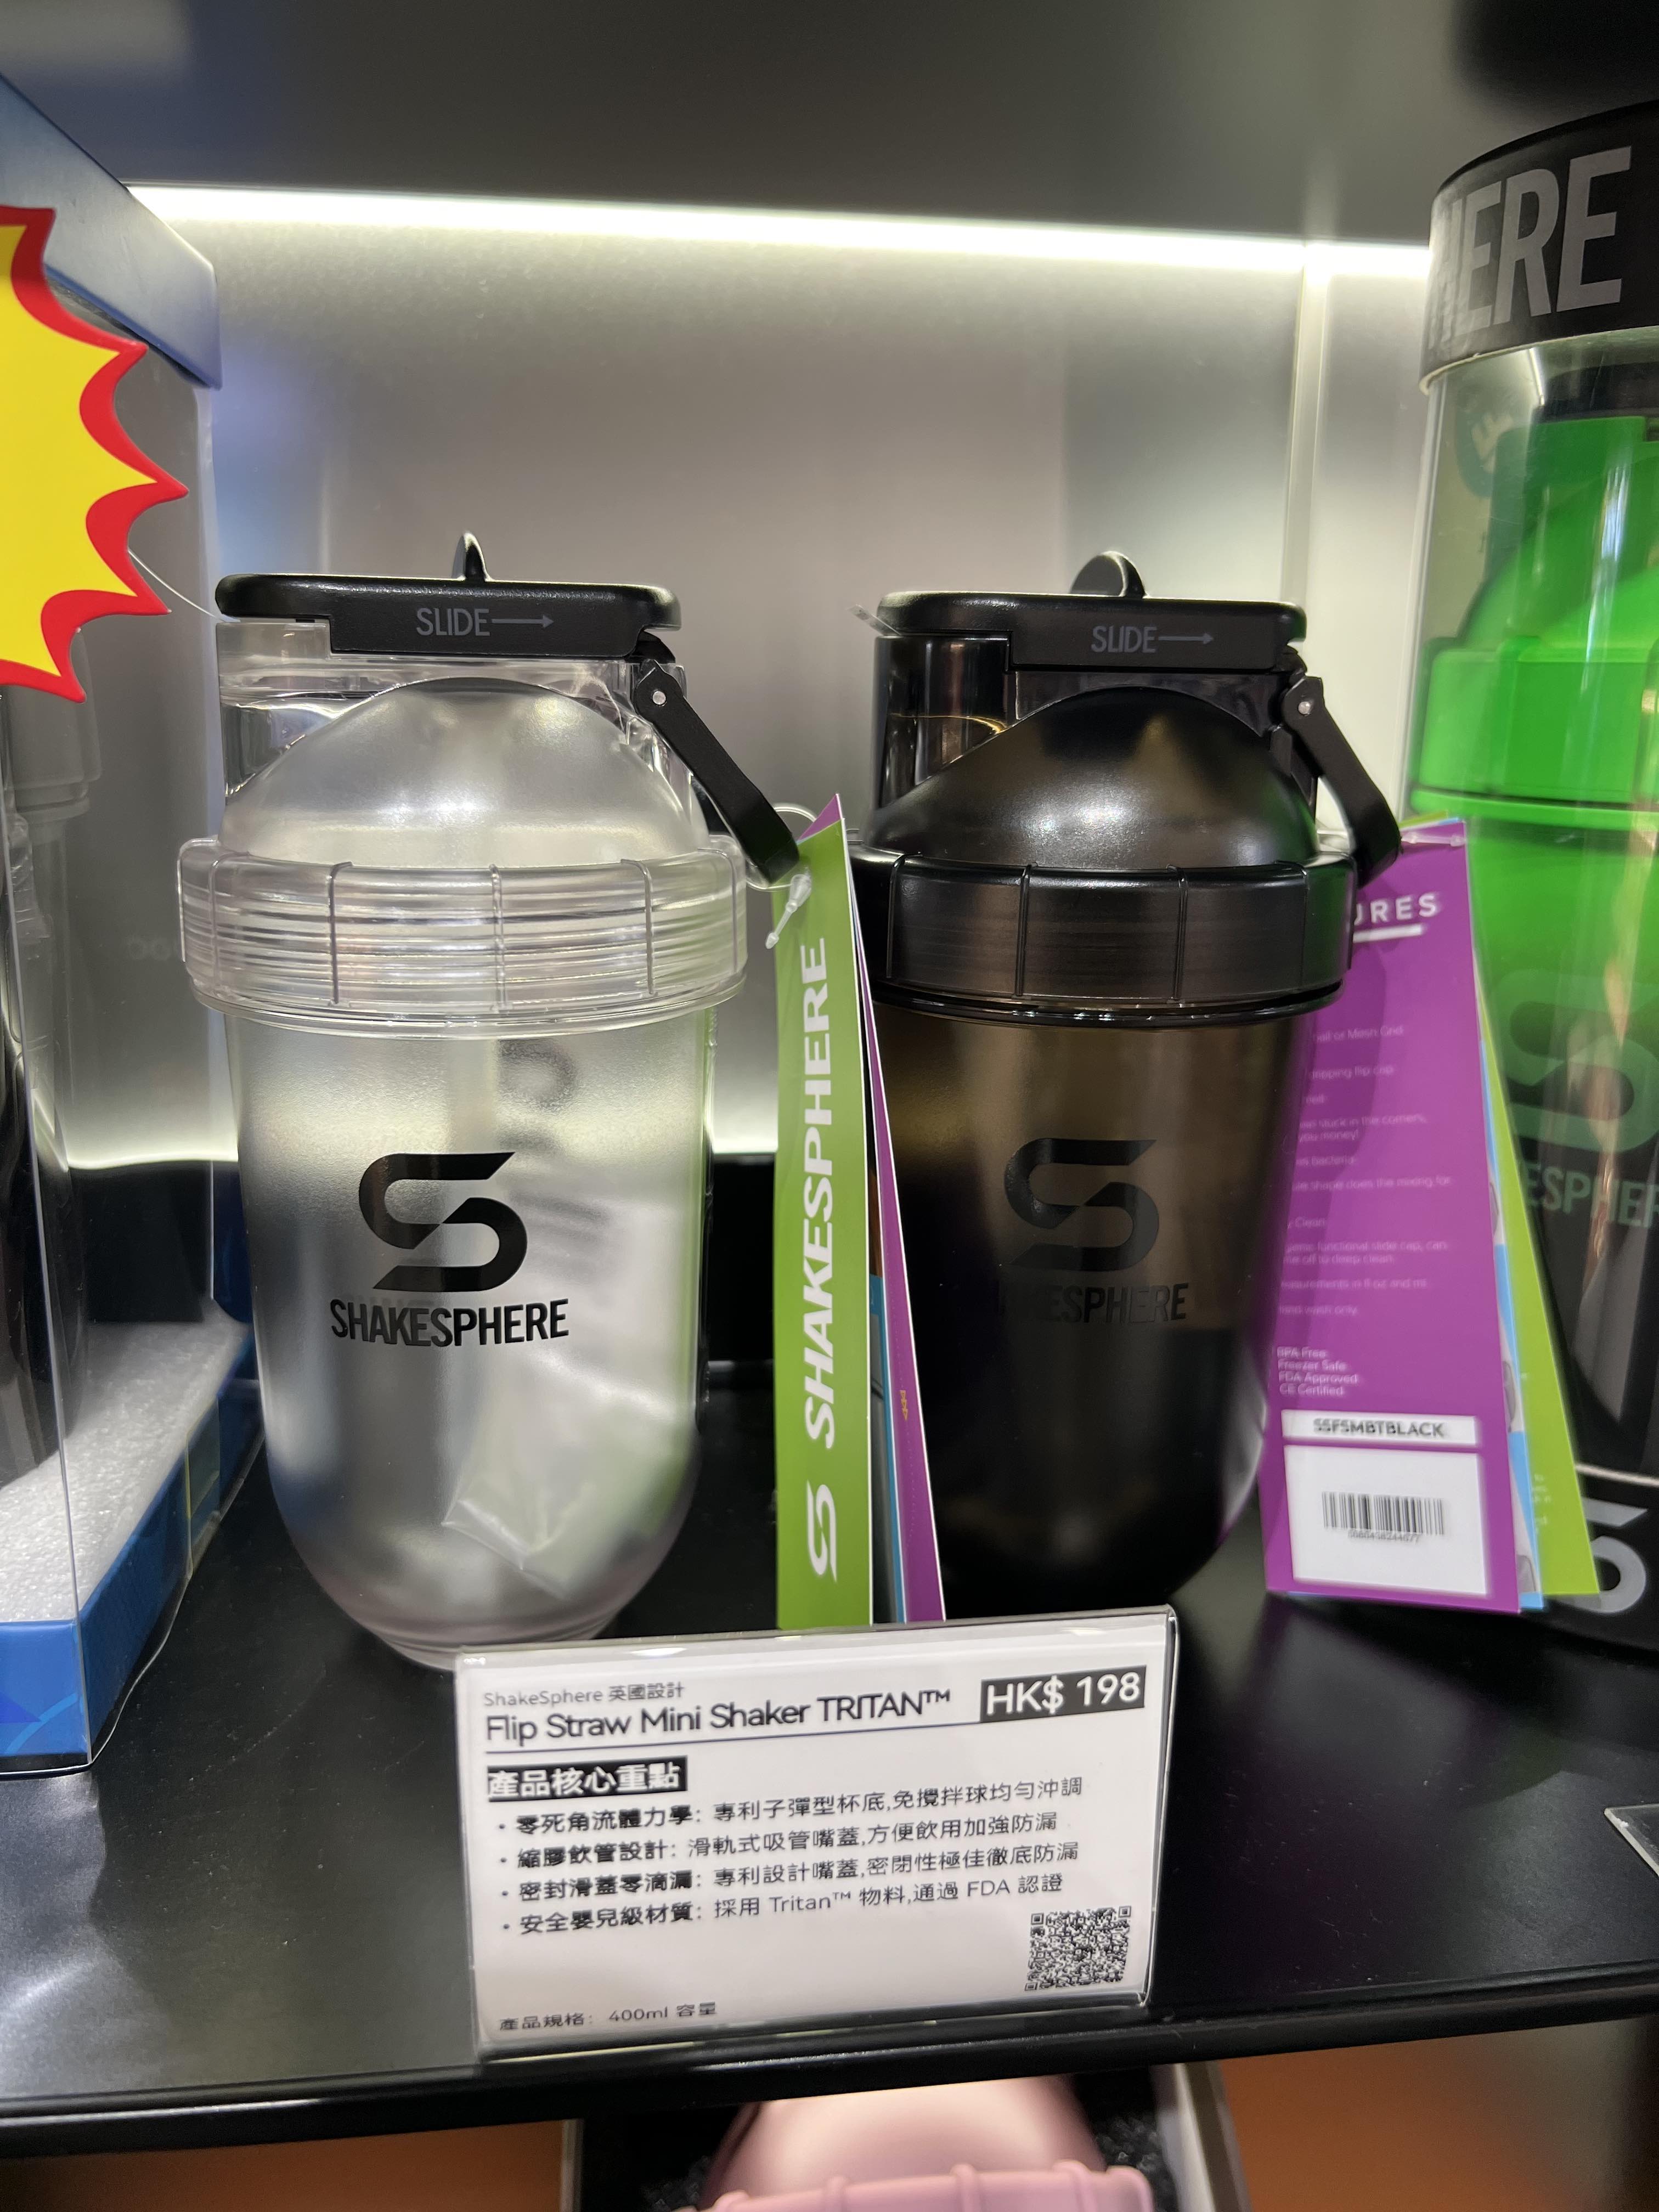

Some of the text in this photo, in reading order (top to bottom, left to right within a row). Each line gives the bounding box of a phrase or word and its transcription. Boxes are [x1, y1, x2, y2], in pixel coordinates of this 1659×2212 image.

[416, 607, 490, 636] SLIDE
[1091, 625, 1157, 653] SLIDE
[800, 938, 834, 1449] SHAKESPHERE
[330, 1298, 569, 1347] SHAKESPHERE
[484, 1681, 685, 1707] ShakeSphere 英國設計
[986, 1672, 1141, 1716] HK$ 198
[486, 1715, 538, 1747] Flip
[546, 1712, 632, 1739] Straw
[642, 1705, 702, 1734] Mini
[710, 1700, 810, 1729] Shaker
[487, 1762, 681, 1799] 產品核心重點
[714, 1896, 760, 1918] 採用
[967, 1880, 1010, 1897] FDA
[1018, 1873, 1063, 1895] 認證
[608, 2006, 668, 2022] 400ml
[676, 2001, 716, 2017] 容量
